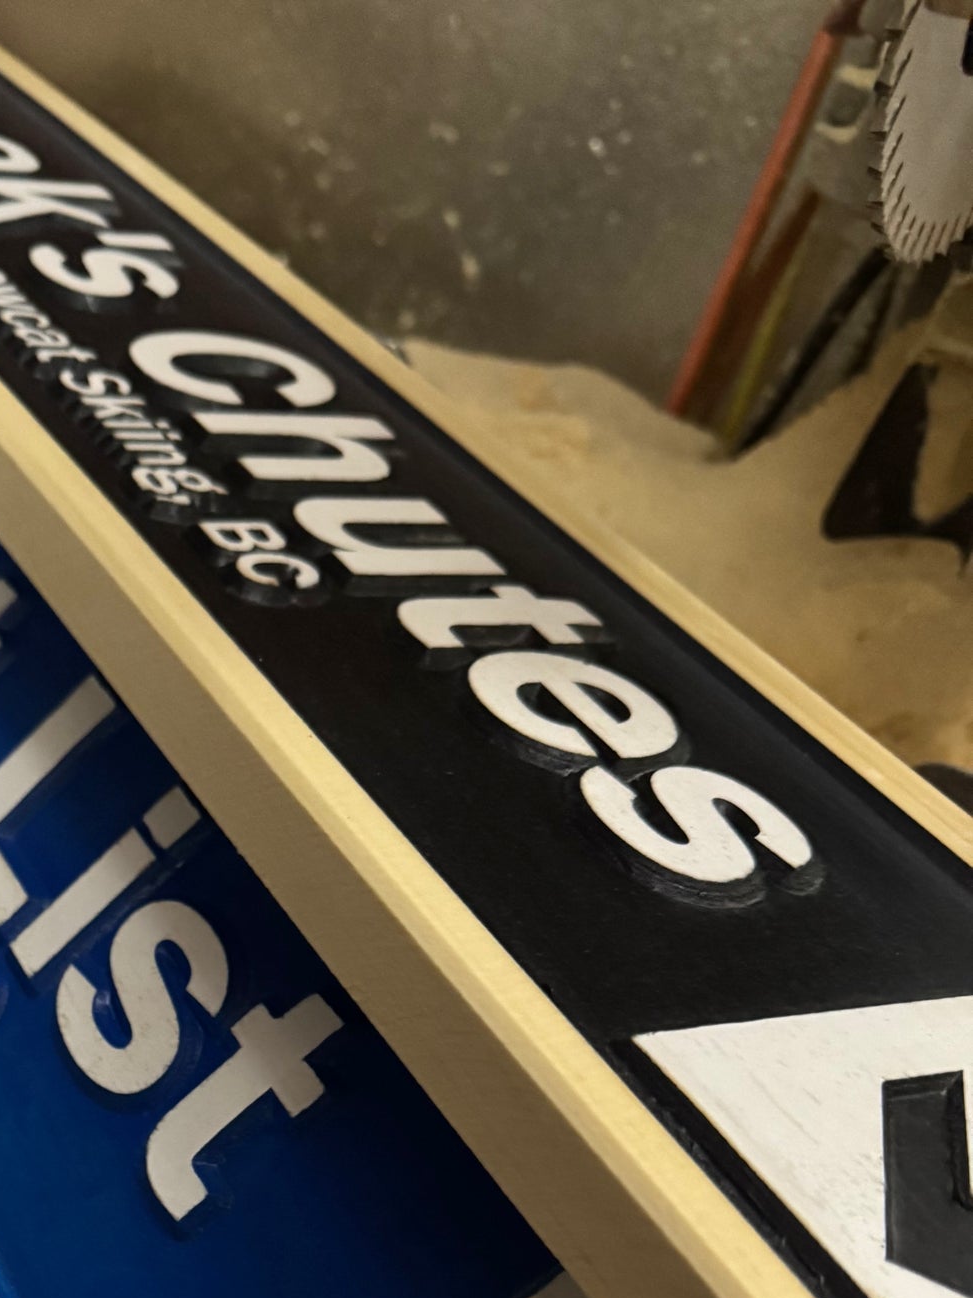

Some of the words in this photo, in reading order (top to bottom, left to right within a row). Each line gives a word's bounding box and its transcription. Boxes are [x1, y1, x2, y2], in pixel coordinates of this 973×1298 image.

[60, 368, 227, 505] Skiing,
[199, 521, 320, 589] BC
[128, 331, 813, 883] Chutes
